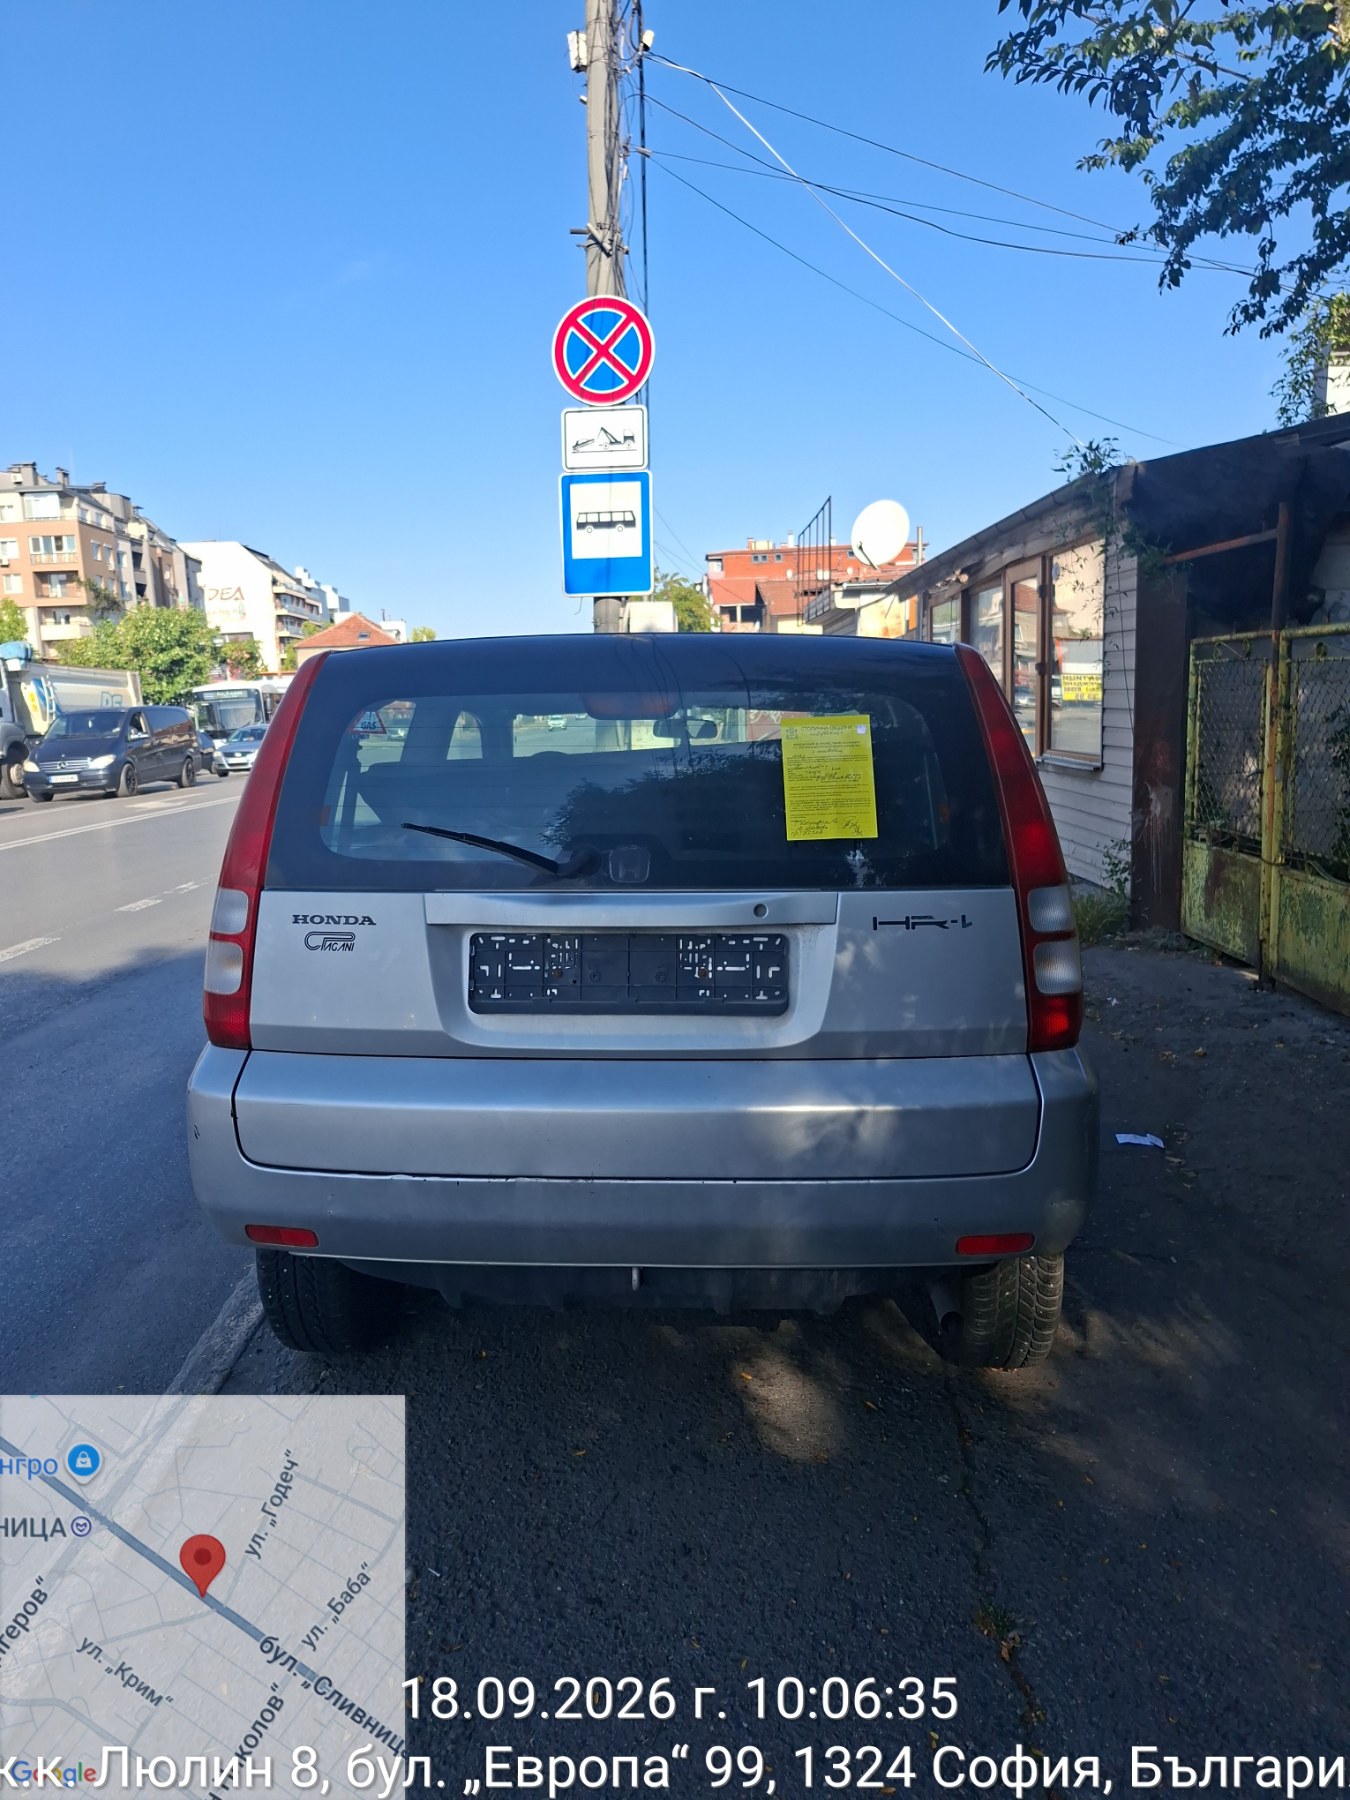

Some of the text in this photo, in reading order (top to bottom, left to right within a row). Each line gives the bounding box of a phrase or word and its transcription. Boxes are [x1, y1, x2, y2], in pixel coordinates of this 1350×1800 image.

[203, 584, 245, 601] DEA
[361, 721, 377, 730] GAS
[292, 914, 377, 926] HONDA
